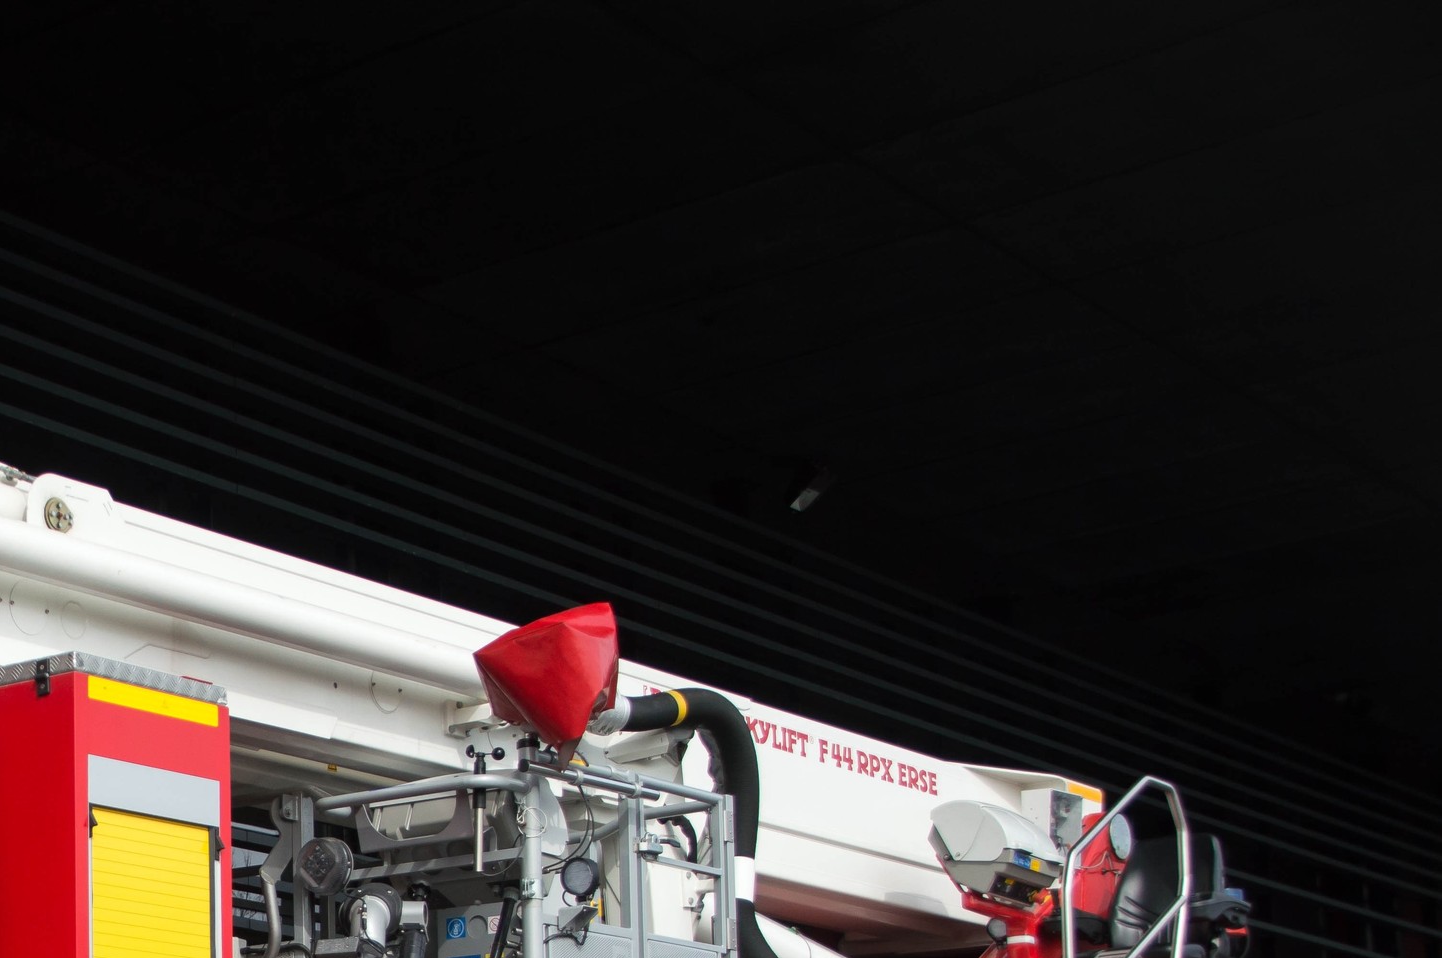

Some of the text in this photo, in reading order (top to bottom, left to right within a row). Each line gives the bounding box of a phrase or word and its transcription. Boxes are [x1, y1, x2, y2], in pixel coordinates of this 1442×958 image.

[818, 738, 829, 764] F
[832, 743, 854, 771] 44
[856, 749, 894, 784] RPX
[898, 762, 938, 796] ERSE
